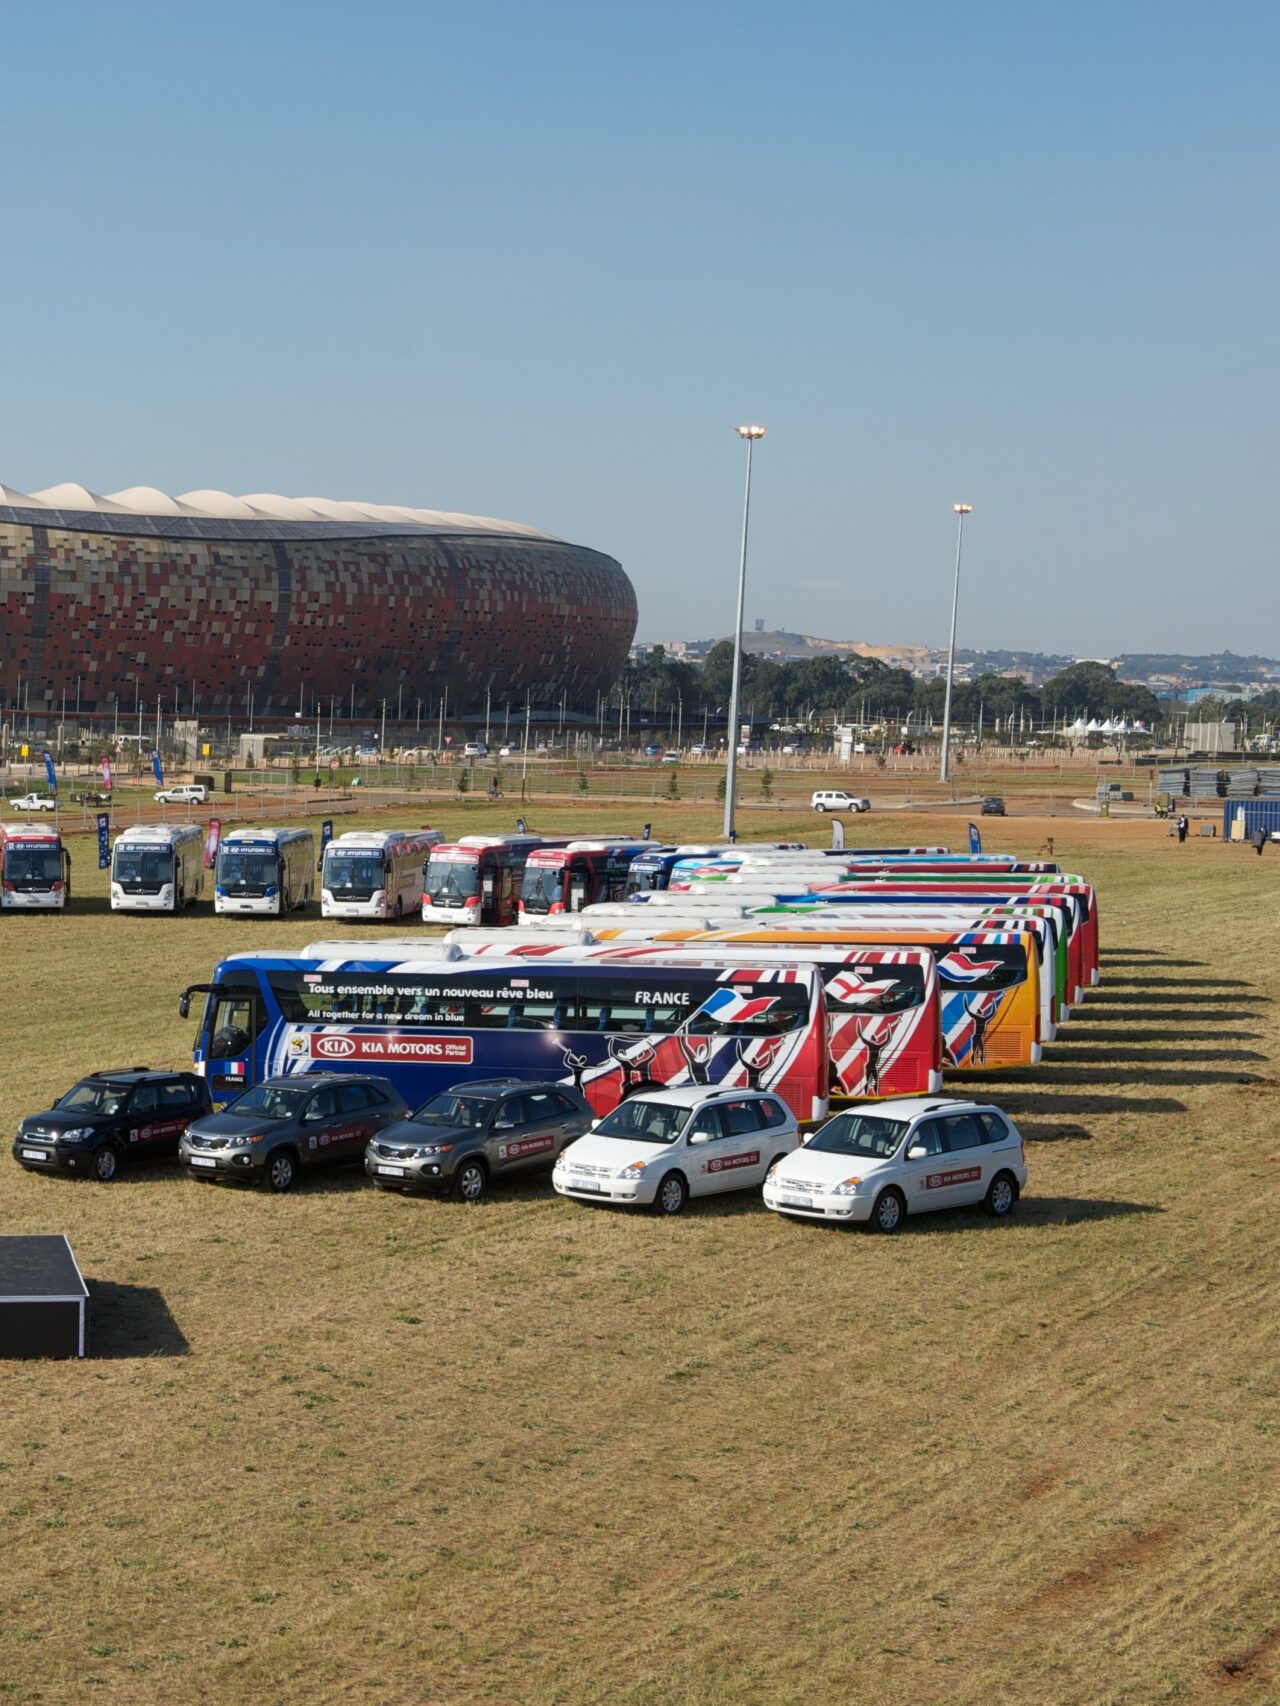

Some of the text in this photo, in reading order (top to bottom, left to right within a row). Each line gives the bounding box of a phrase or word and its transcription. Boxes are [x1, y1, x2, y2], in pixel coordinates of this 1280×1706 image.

[308, 983, 554, 999] Tous ensemble vers un nouveau rêve bleu
[634, 990, 690, 1005] FRANCE
[307, 1009, 320, 1018] All
[322, 1010, 359, 1021] together
[361, 1011, 374, 1020] for
[404, 1012, 433, 1021] dream
[434, 1012, 444, 1021] in
[445, 1012, 465, 1022] blue
[323, 1041, 350, 1053] KIA
[361, 1042, 442, 1055] KIA MOTORS
[445, 1043, 467, 1051] Official
[952, 1171, 970, 1181] MOTORS
